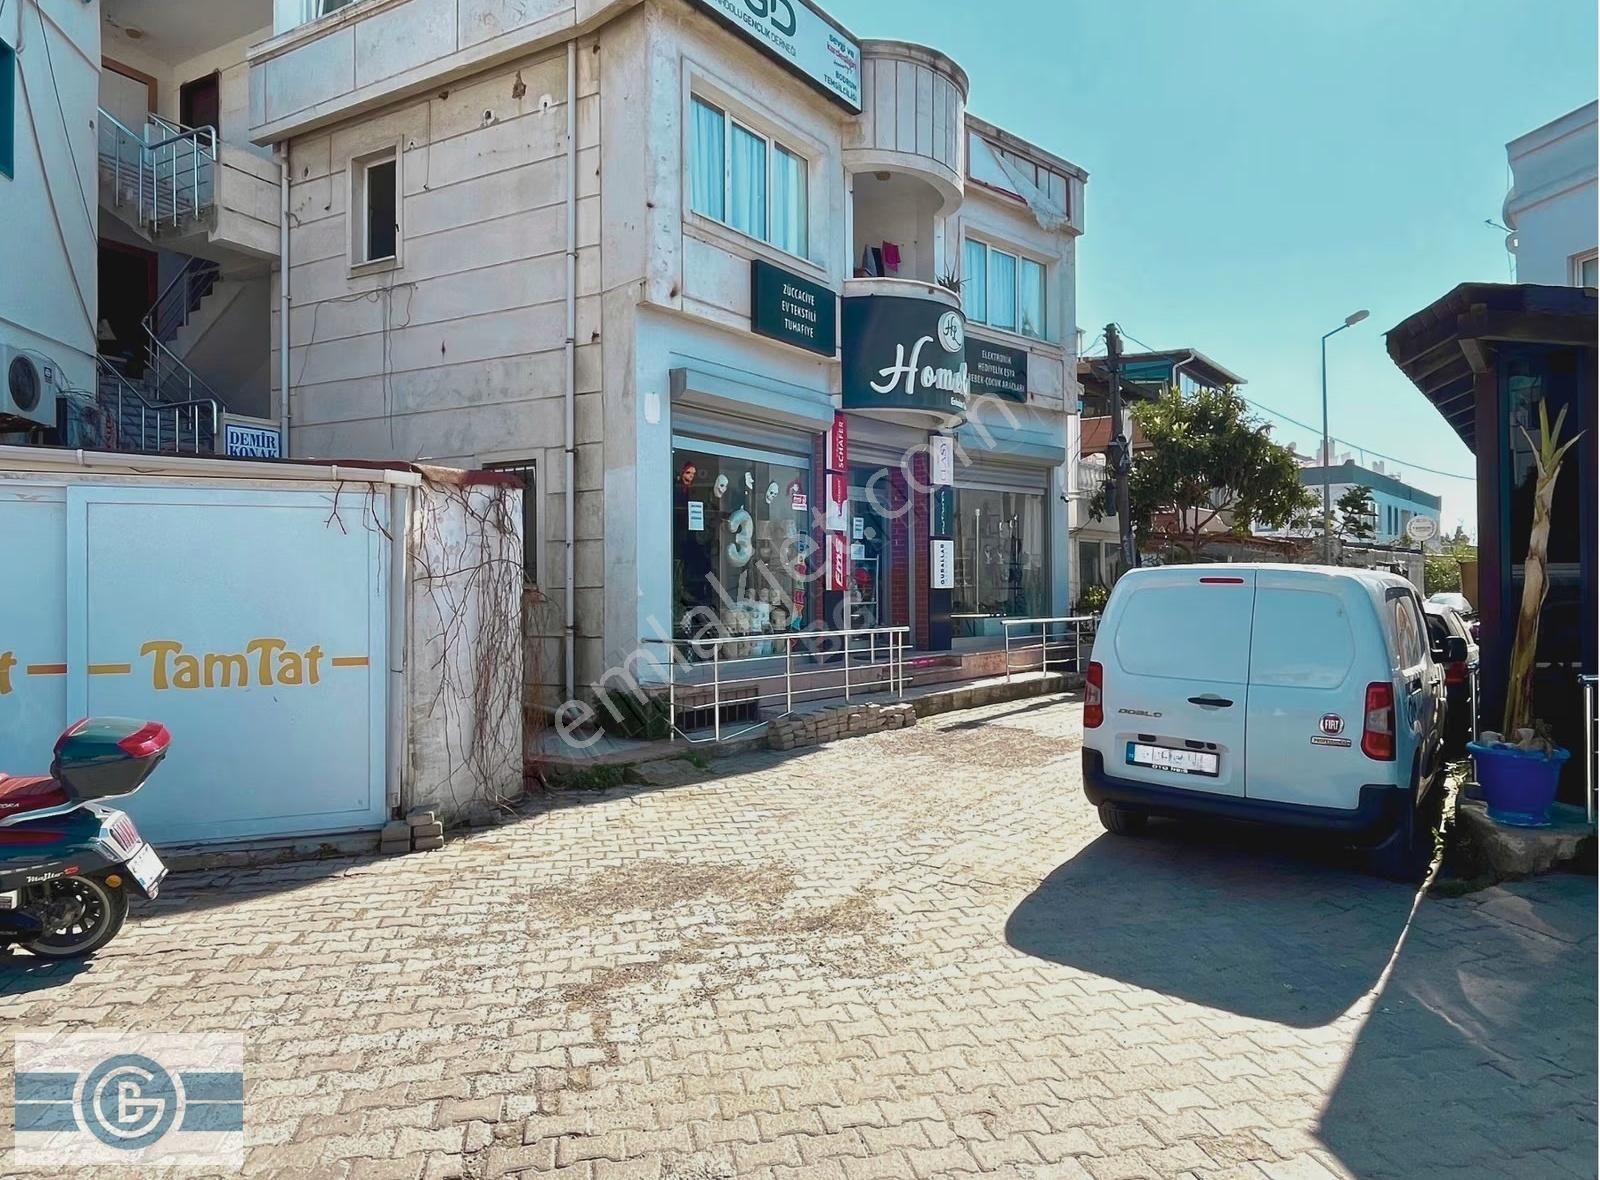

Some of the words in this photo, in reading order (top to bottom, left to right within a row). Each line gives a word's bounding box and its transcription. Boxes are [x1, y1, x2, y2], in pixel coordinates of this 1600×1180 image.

[781, 300, 790, 312] EV
[230, 431, 276, 449] DEMİR
[138, 637, 325, 691] TamTat
[1325, 719, 1339, 730] FIAT
